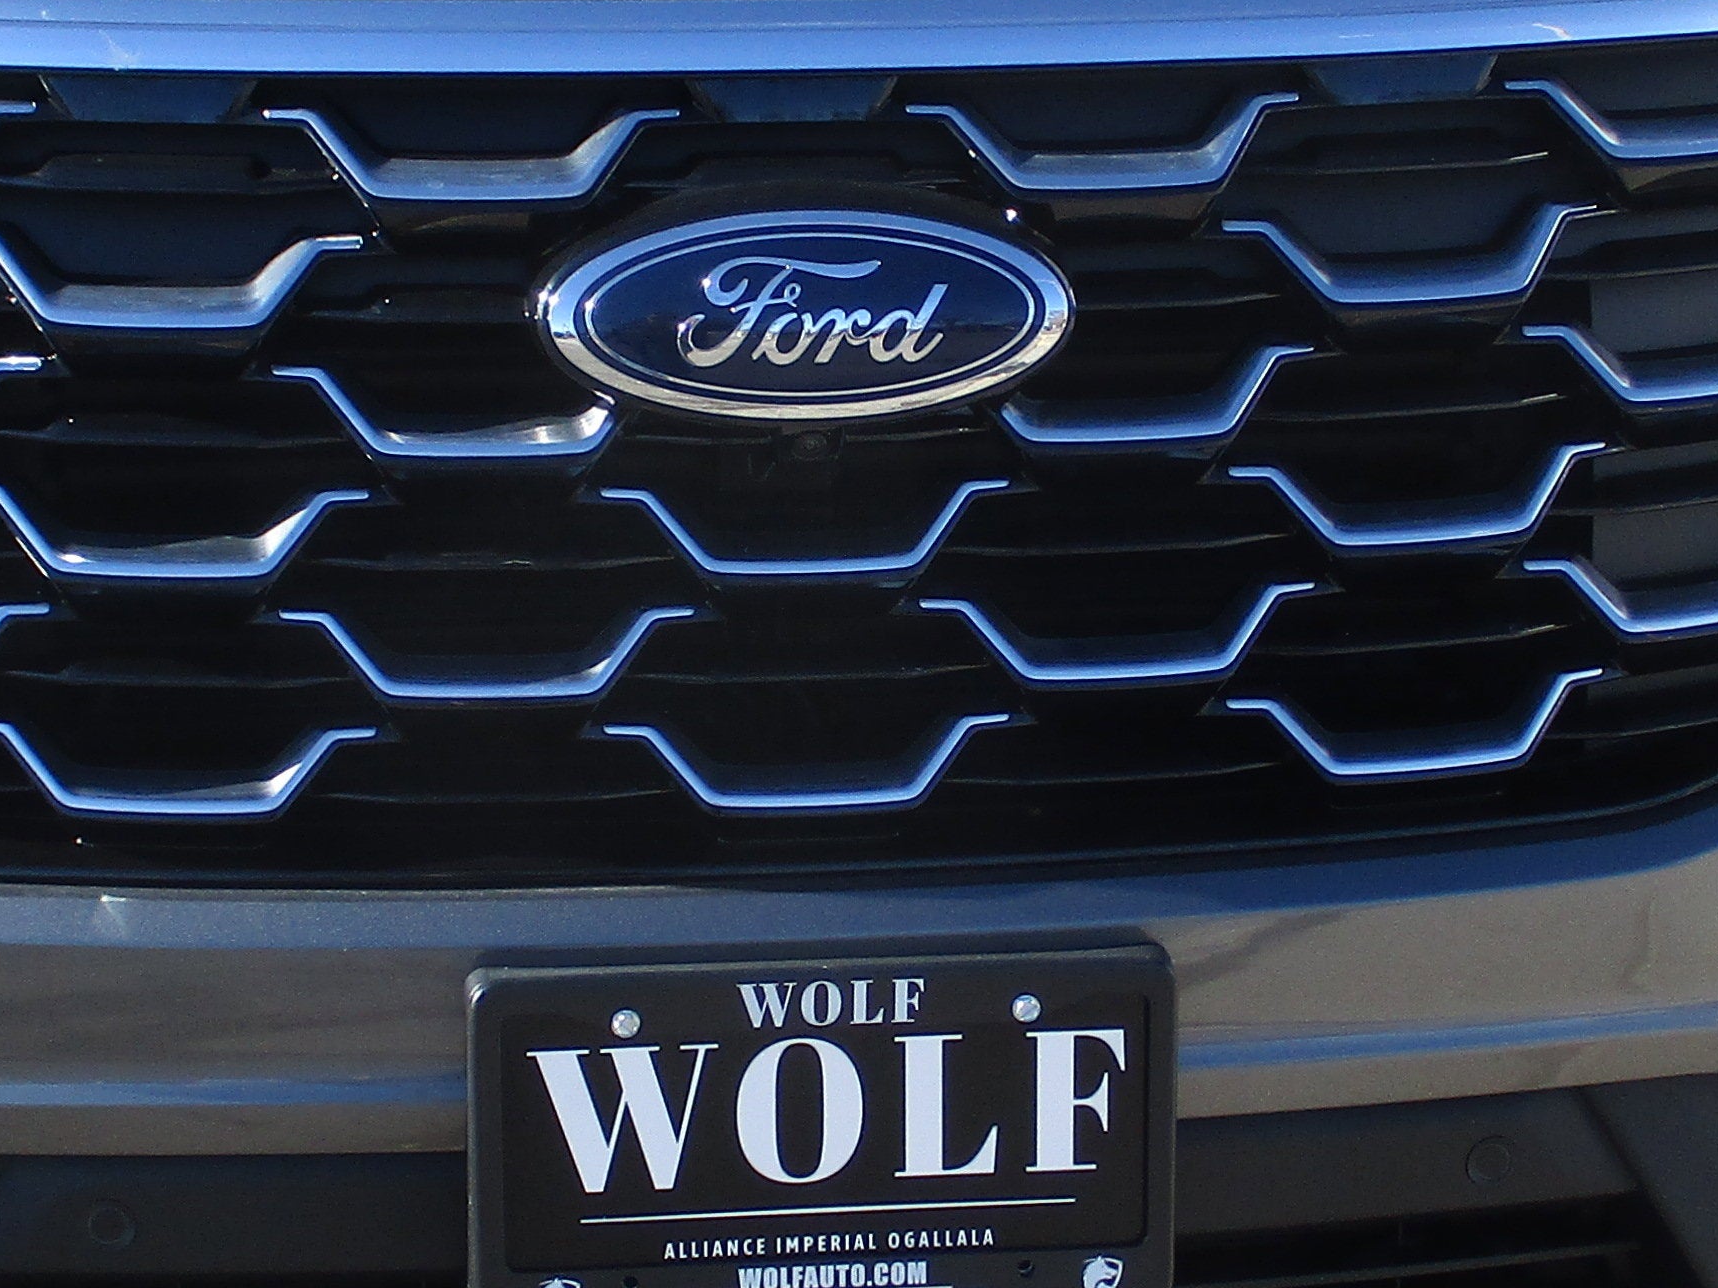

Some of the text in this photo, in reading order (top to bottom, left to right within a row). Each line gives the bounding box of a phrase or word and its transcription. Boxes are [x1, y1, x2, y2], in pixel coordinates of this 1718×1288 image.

[677, 255, 949, 368] Ford
[736, 978, 925, 1028] WOLF
[526, 1028, 1127, 1194] WOLF
[663, 1228, 995, 1260] ALLIANCE IMPERIAL OGALLALA
